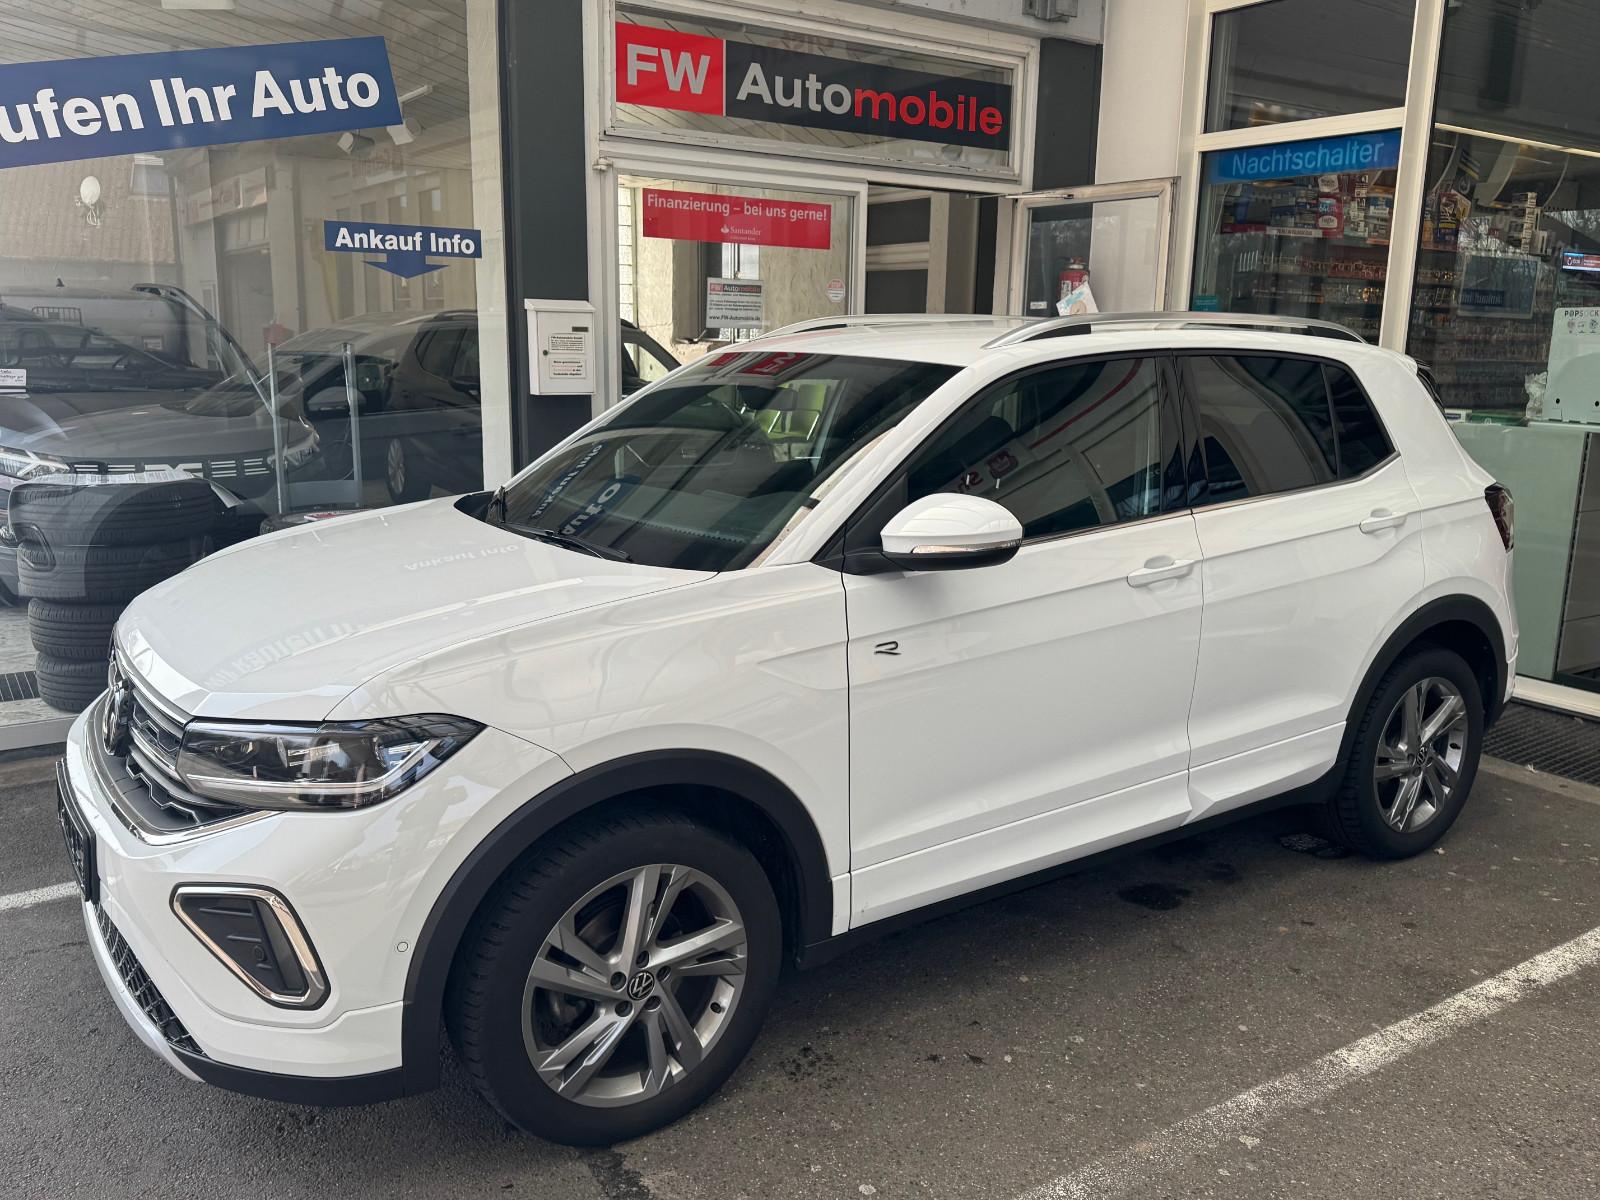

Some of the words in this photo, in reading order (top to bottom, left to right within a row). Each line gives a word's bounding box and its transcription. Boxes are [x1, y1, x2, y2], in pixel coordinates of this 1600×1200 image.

[149, 76, 238, 127] Ihr
[251, 66, 381, 118] Auto
[626, 42, 711, 95] FW
[735, 61, 1003, 136] Automobile
[1231, 141, 1385, 177] Nachtschalter
[646, 193, 730, 216] Finanzierung
[743, 202, 763, 216] bei
[765, 207, 787, 218] uns
[789, 208, 828, 222] gerne!
[334, 226, 424, 252] Ankauf
[430, 232, 476, 255] Info
[730, 225, 761, 236] Santander
